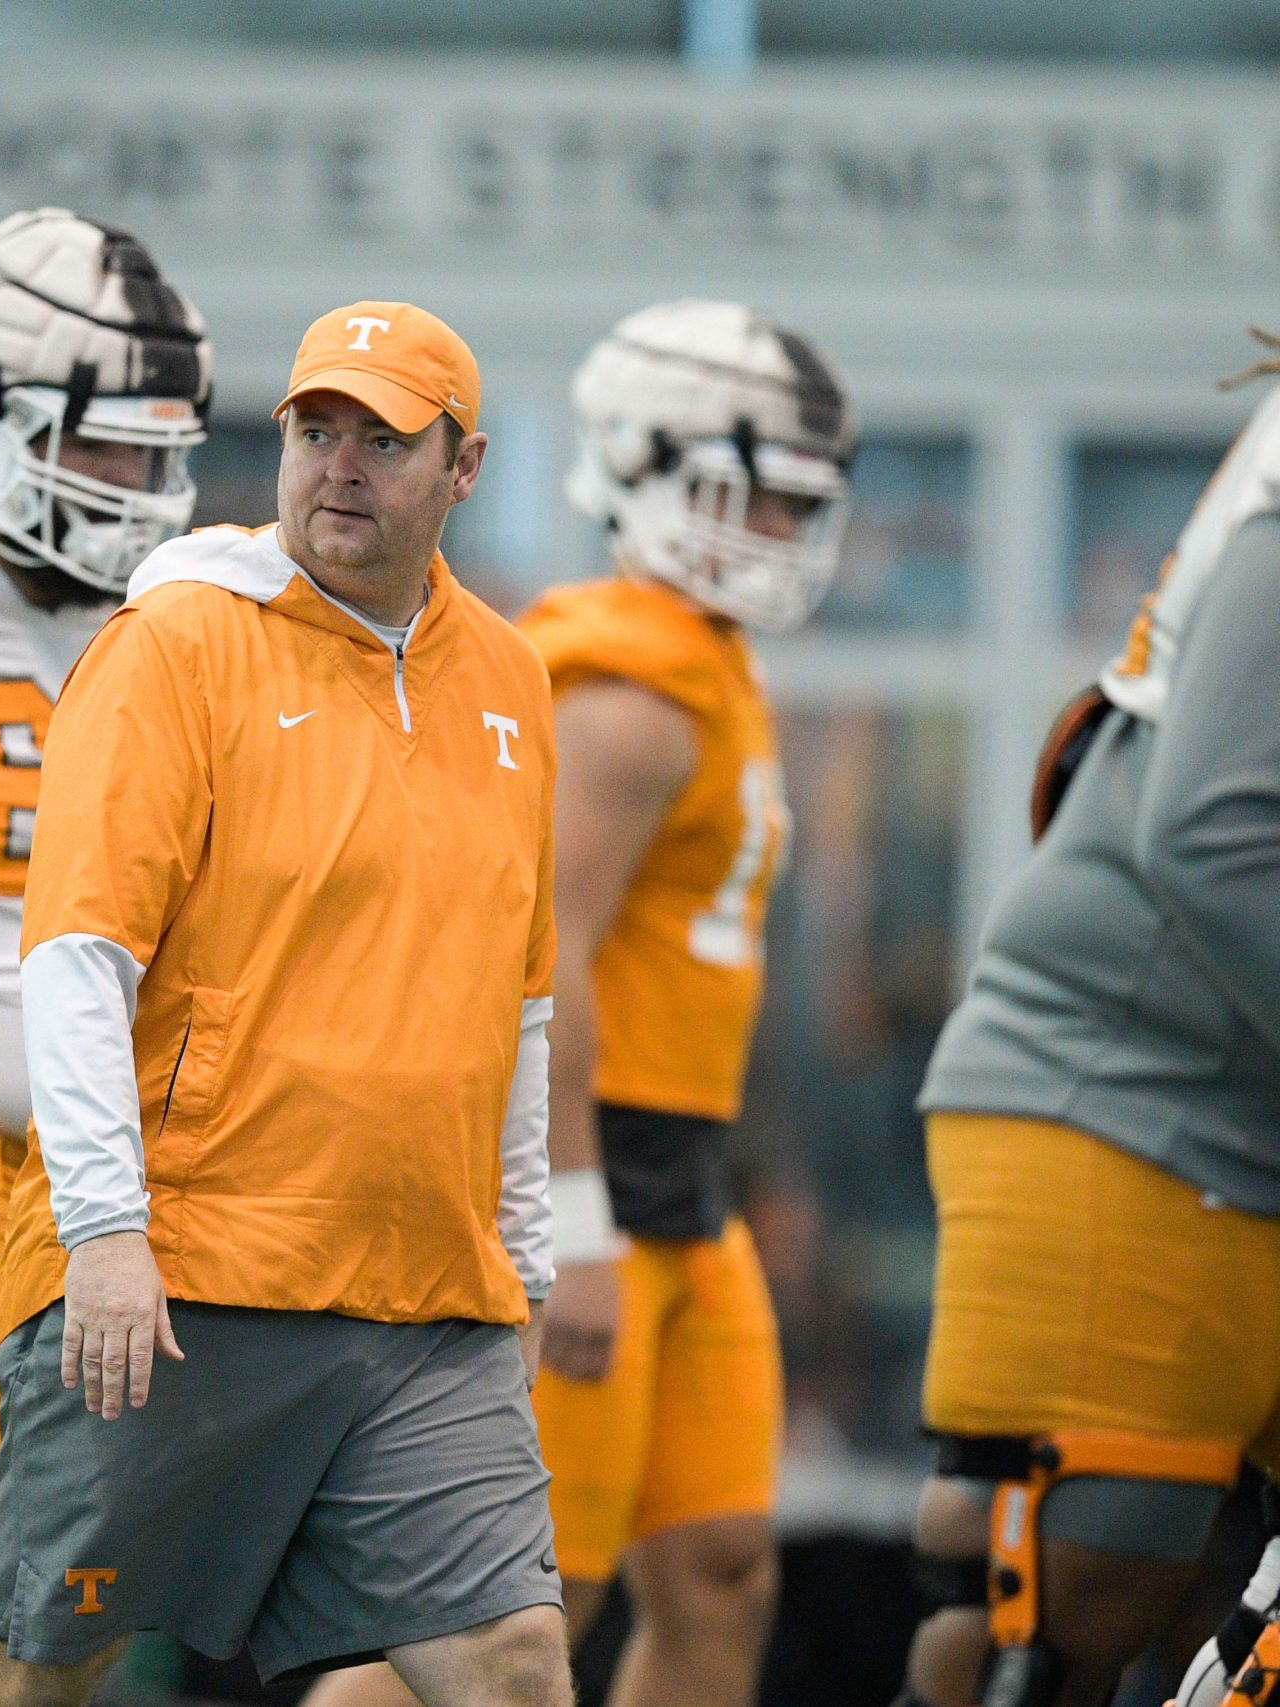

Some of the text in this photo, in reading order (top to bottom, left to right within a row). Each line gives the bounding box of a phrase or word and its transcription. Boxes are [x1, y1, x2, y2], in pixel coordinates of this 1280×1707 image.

[345, 316, 390, 351] T
[481, 710, 520, 770] T
[65, 1568, 117, 1615] T
